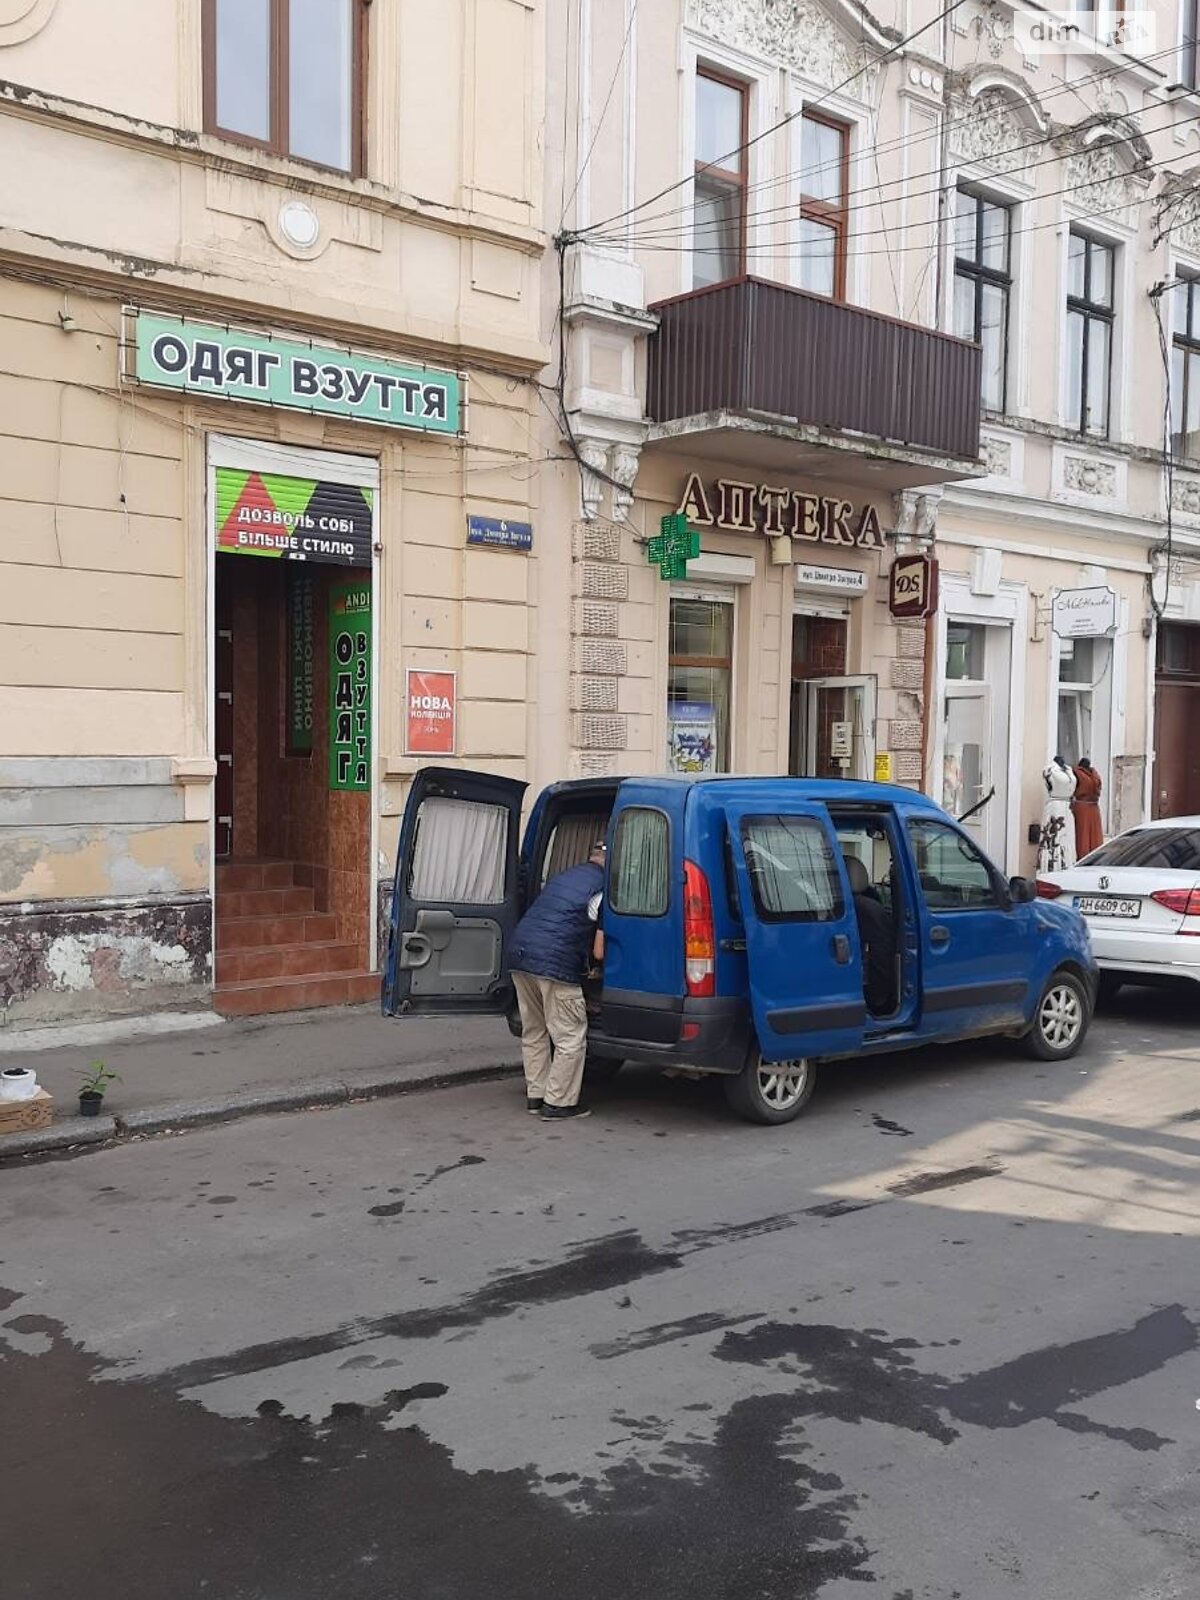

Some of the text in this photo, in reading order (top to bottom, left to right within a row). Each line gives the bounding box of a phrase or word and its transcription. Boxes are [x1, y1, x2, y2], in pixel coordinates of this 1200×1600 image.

[152, 333, 447, 420] ОДЯГ ВЗУТТЯ
[238, 507, 354, 534] ДОЗВОЛЬ СОБІ
[677, 472, 888, 550] АПТЕКА
[501, 521, 508, 531] 6
[238, 532, 354, 556] БІЛЬШЕ СТИЛЮ
[335, 631, 354, 784] ОДЯГ
[355, 631, 367, 784] ВЗУТТЯ
[411, 695, 452, 711] НОВА
[1094, 900, 1118, 910] 6609
[1119, 901, 1136, 913] OK
